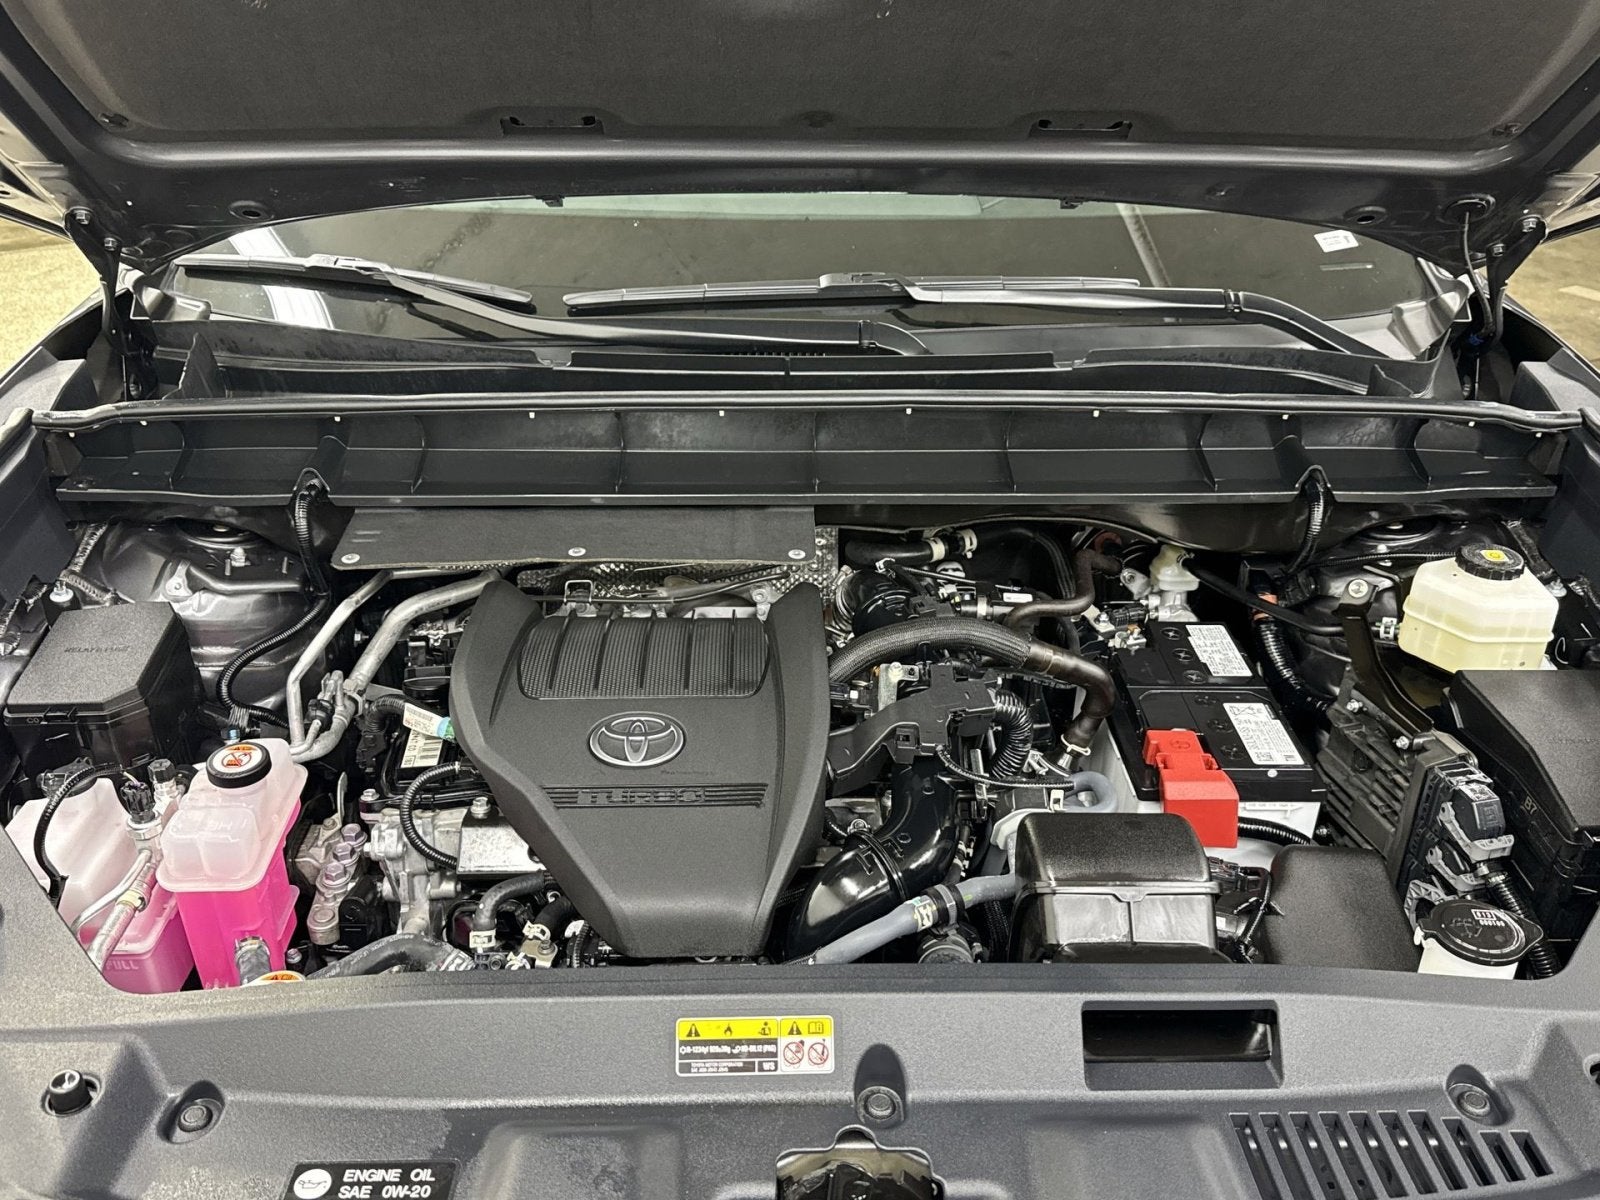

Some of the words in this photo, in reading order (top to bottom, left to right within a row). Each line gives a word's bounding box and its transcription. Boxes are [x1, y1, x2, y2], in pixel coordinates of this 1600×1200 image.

[1523, 796, 1538, 815] B7
[343, 1168, 402, 1182] ENGINE
[410, 1168, 435, 1182] OIL
[338, 1185, 372, 1198] SAE
[381, 1185, 431, 1198] 0W-20
